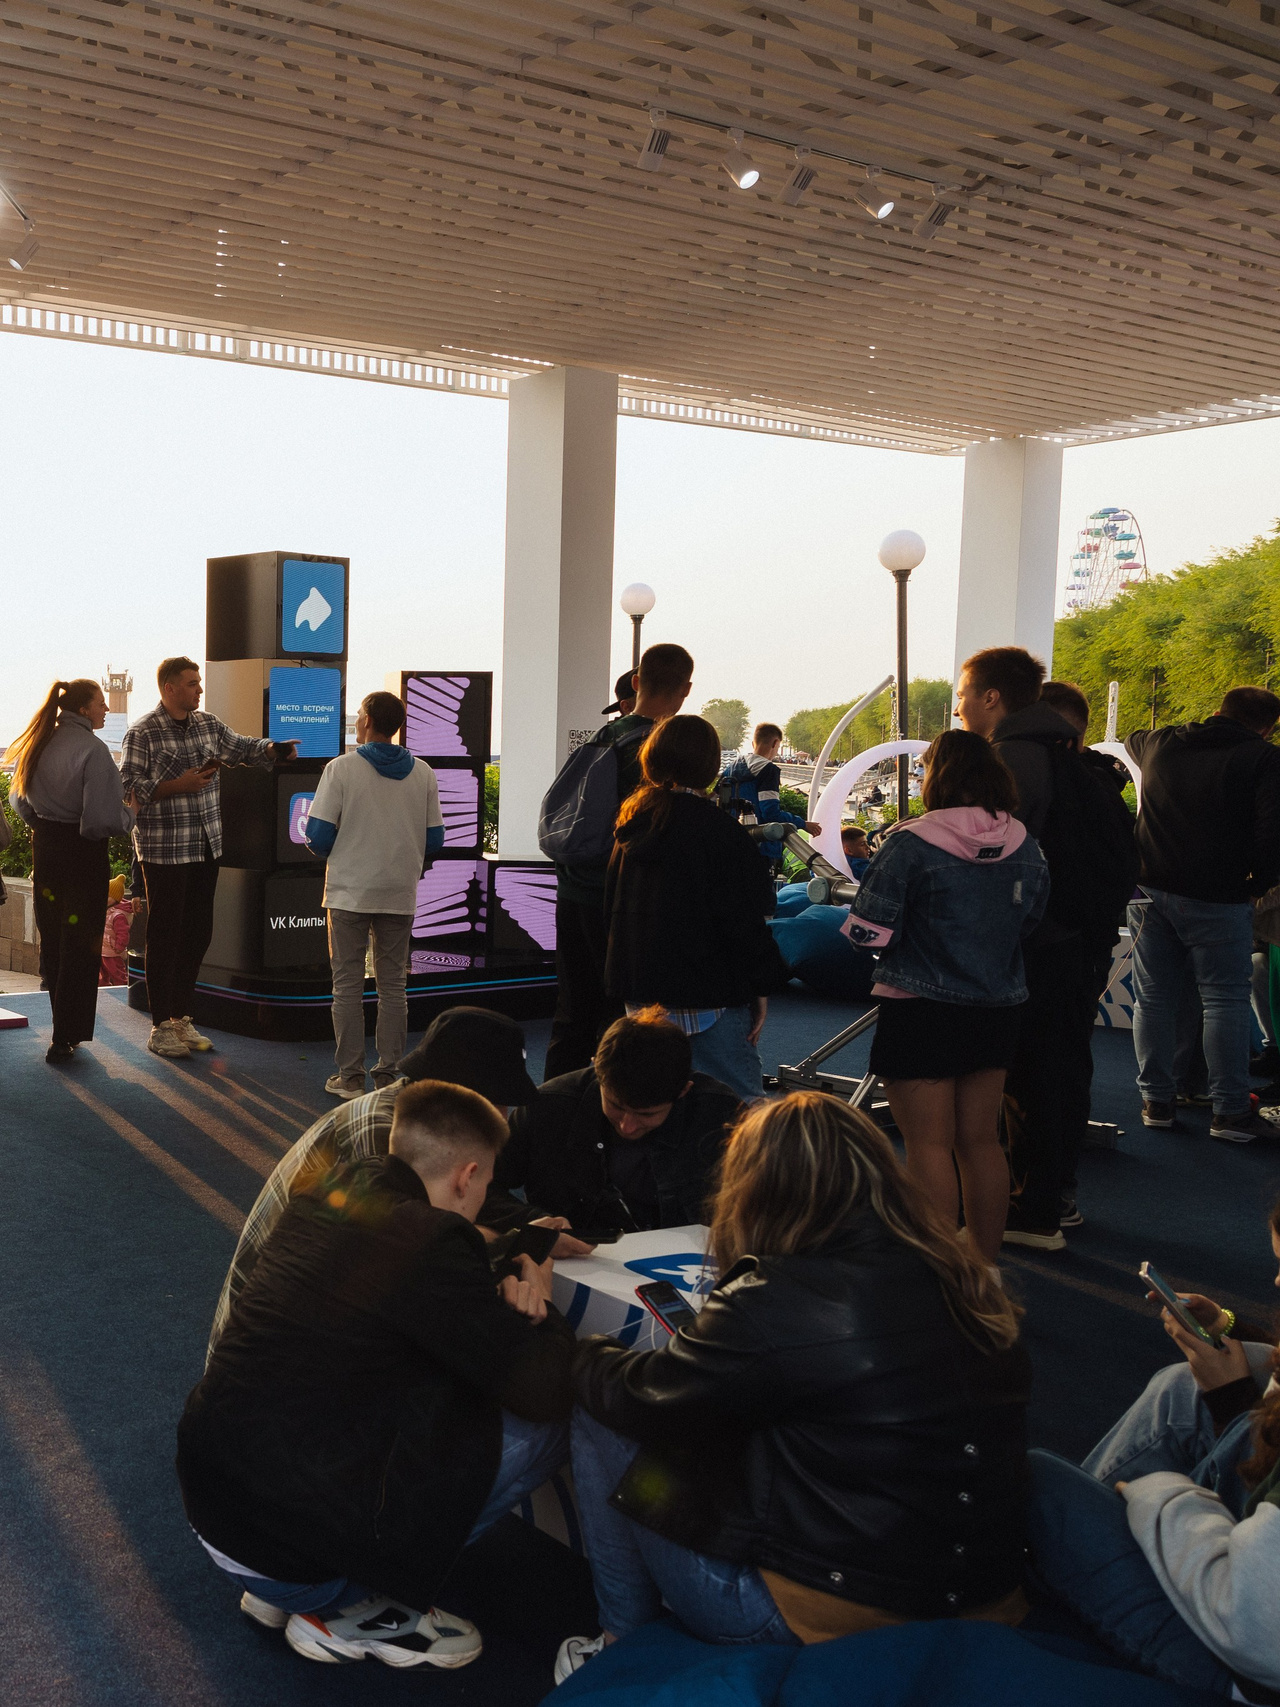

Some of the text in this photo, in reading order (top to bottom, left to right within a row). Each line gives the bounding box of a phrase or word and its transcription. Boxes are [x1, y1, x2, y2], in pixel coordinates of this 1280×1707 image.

[275, 704, 335, 713] место встречи
[280, 715, 330, 723] впечатлений
[269, 915, 326, 930] VK Клипы
